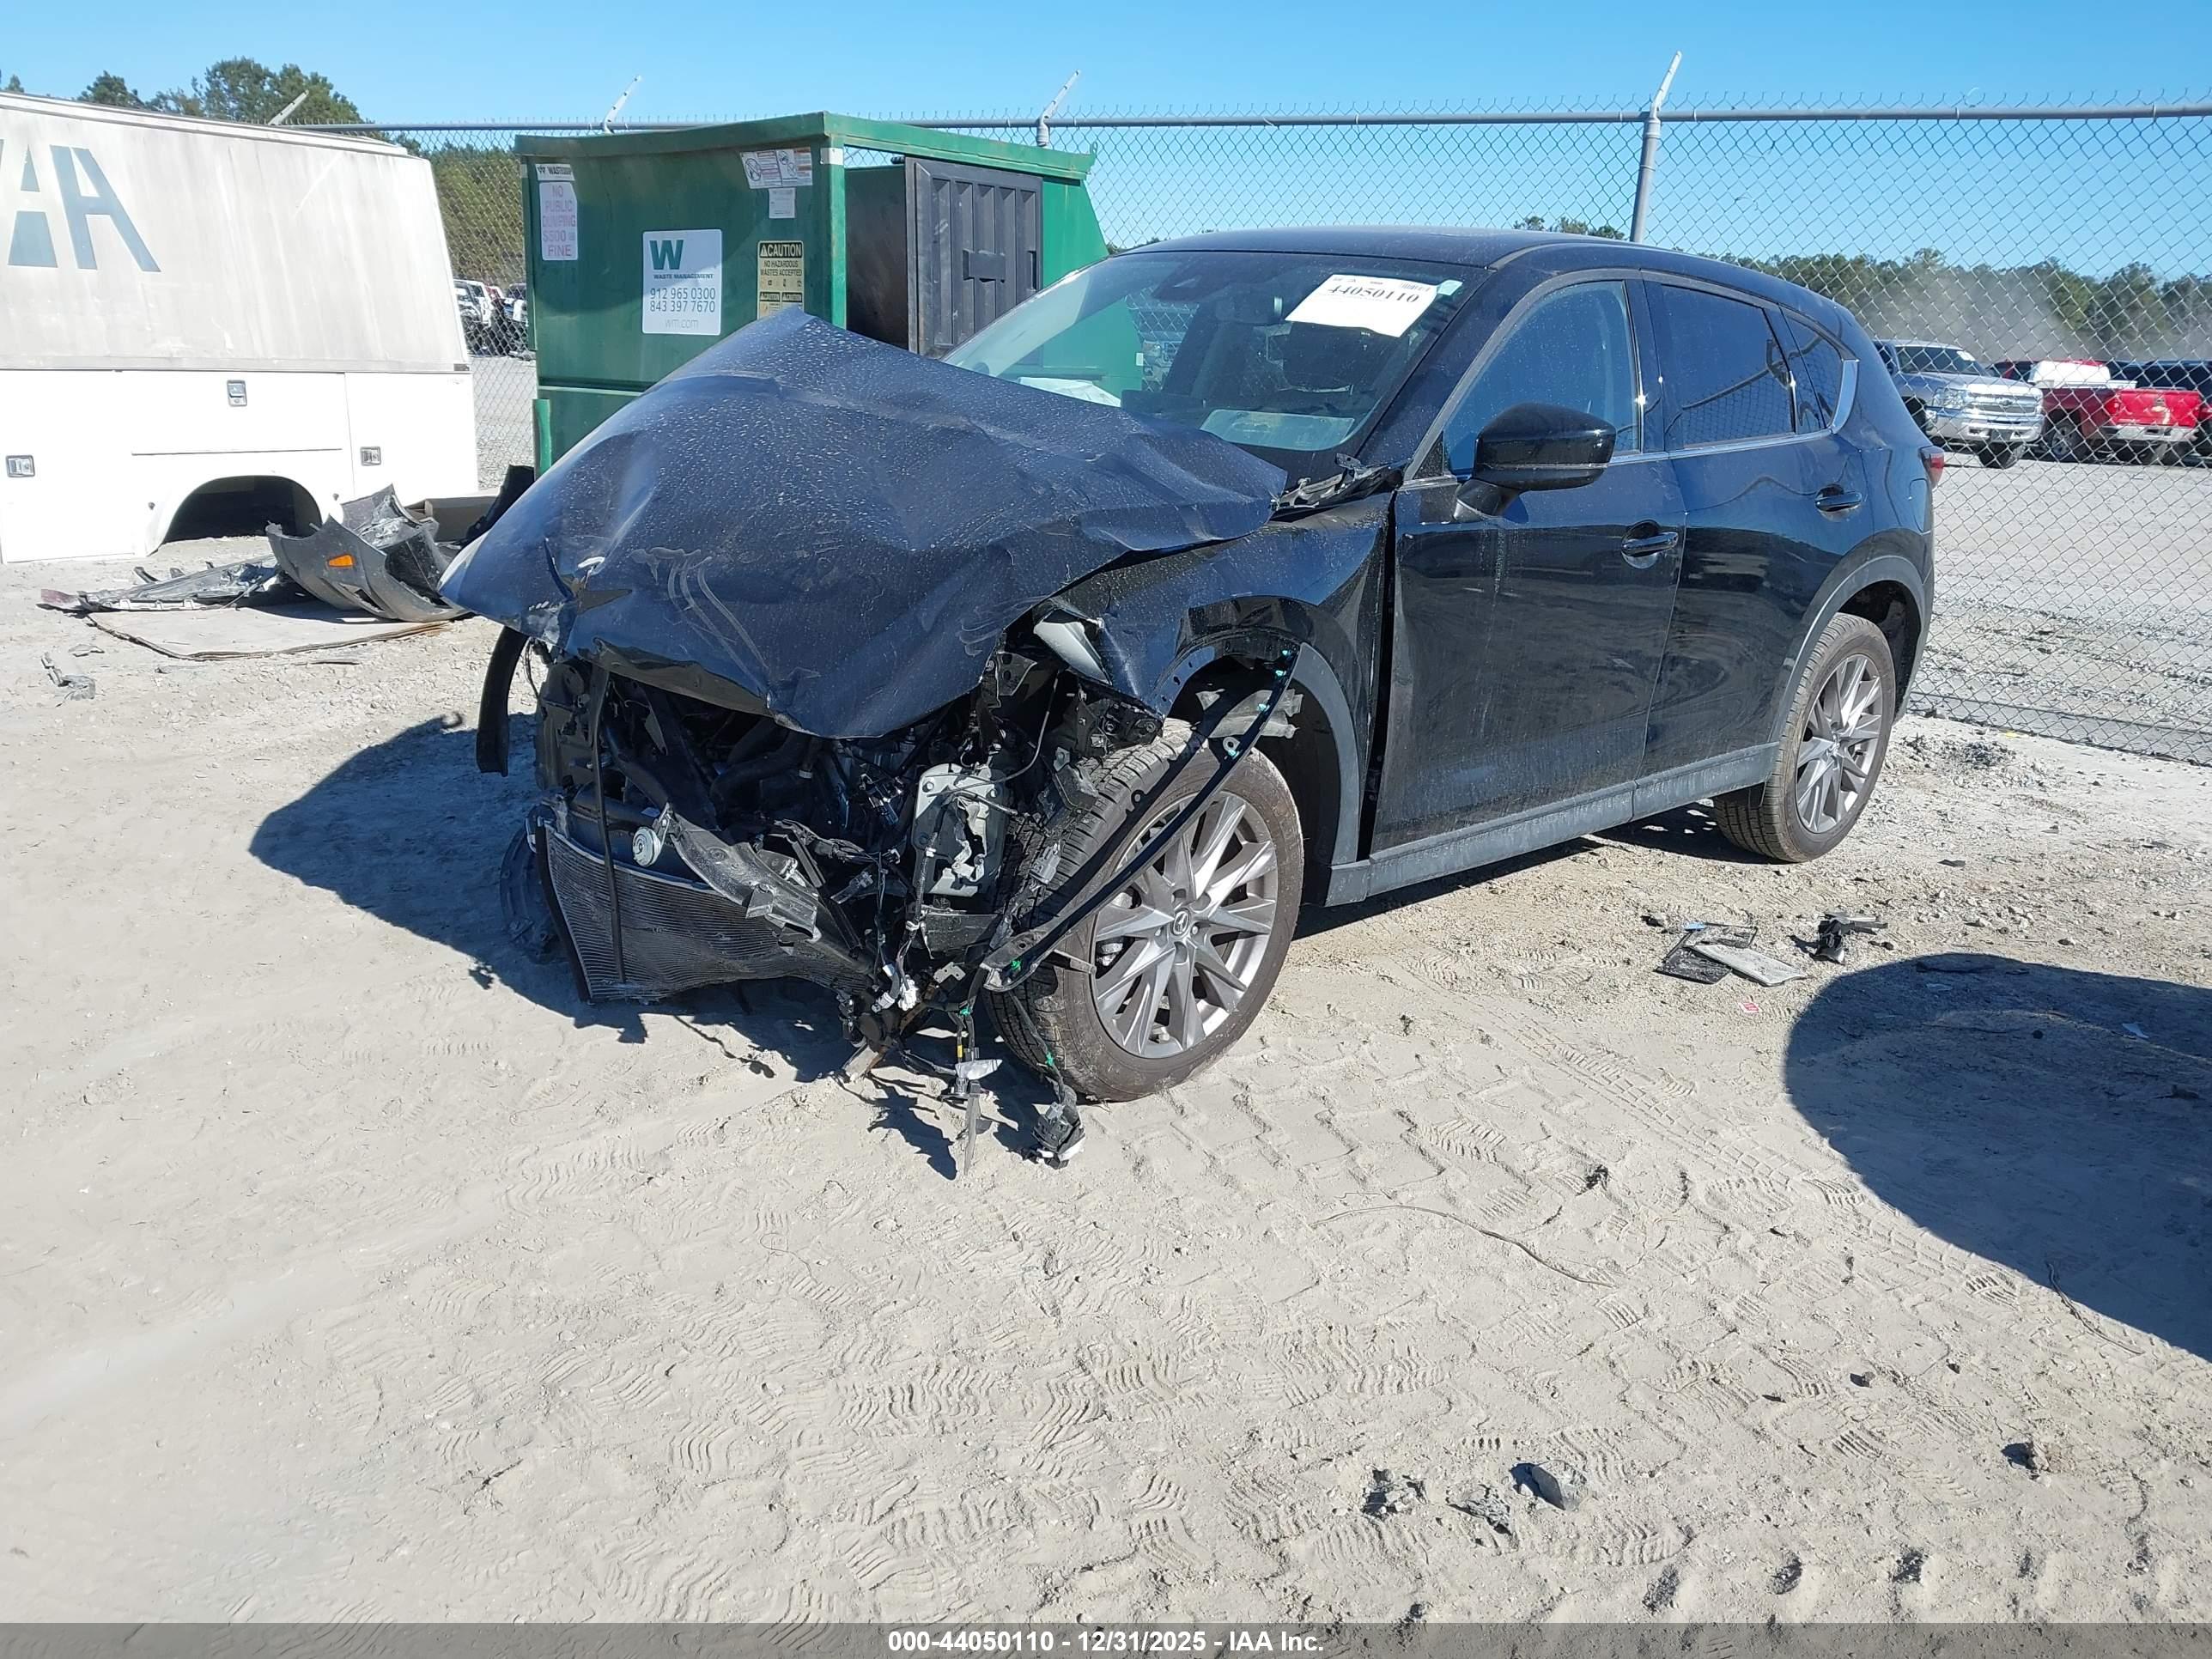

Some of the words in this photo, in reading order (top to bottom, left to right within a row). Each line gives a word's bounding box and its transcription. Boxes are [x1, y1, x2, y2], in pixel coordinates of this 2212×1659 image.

[552, 185, 564, 198] NO
[548, 244, 571, 256] FINE
[649, 240, 684, 270] W
[767, 244, 802, 257] CAUTION
[650, 288, 667, 300] 912
[670, 288, 688, 300] 965
[690, 288, 716, 300] 0300
[1328, 285, 1419, 303] 44050110
[650, 301, 667, 312] 843
[670, 301, 688, 312] 397
[690, 301, 715, 313] 7670
